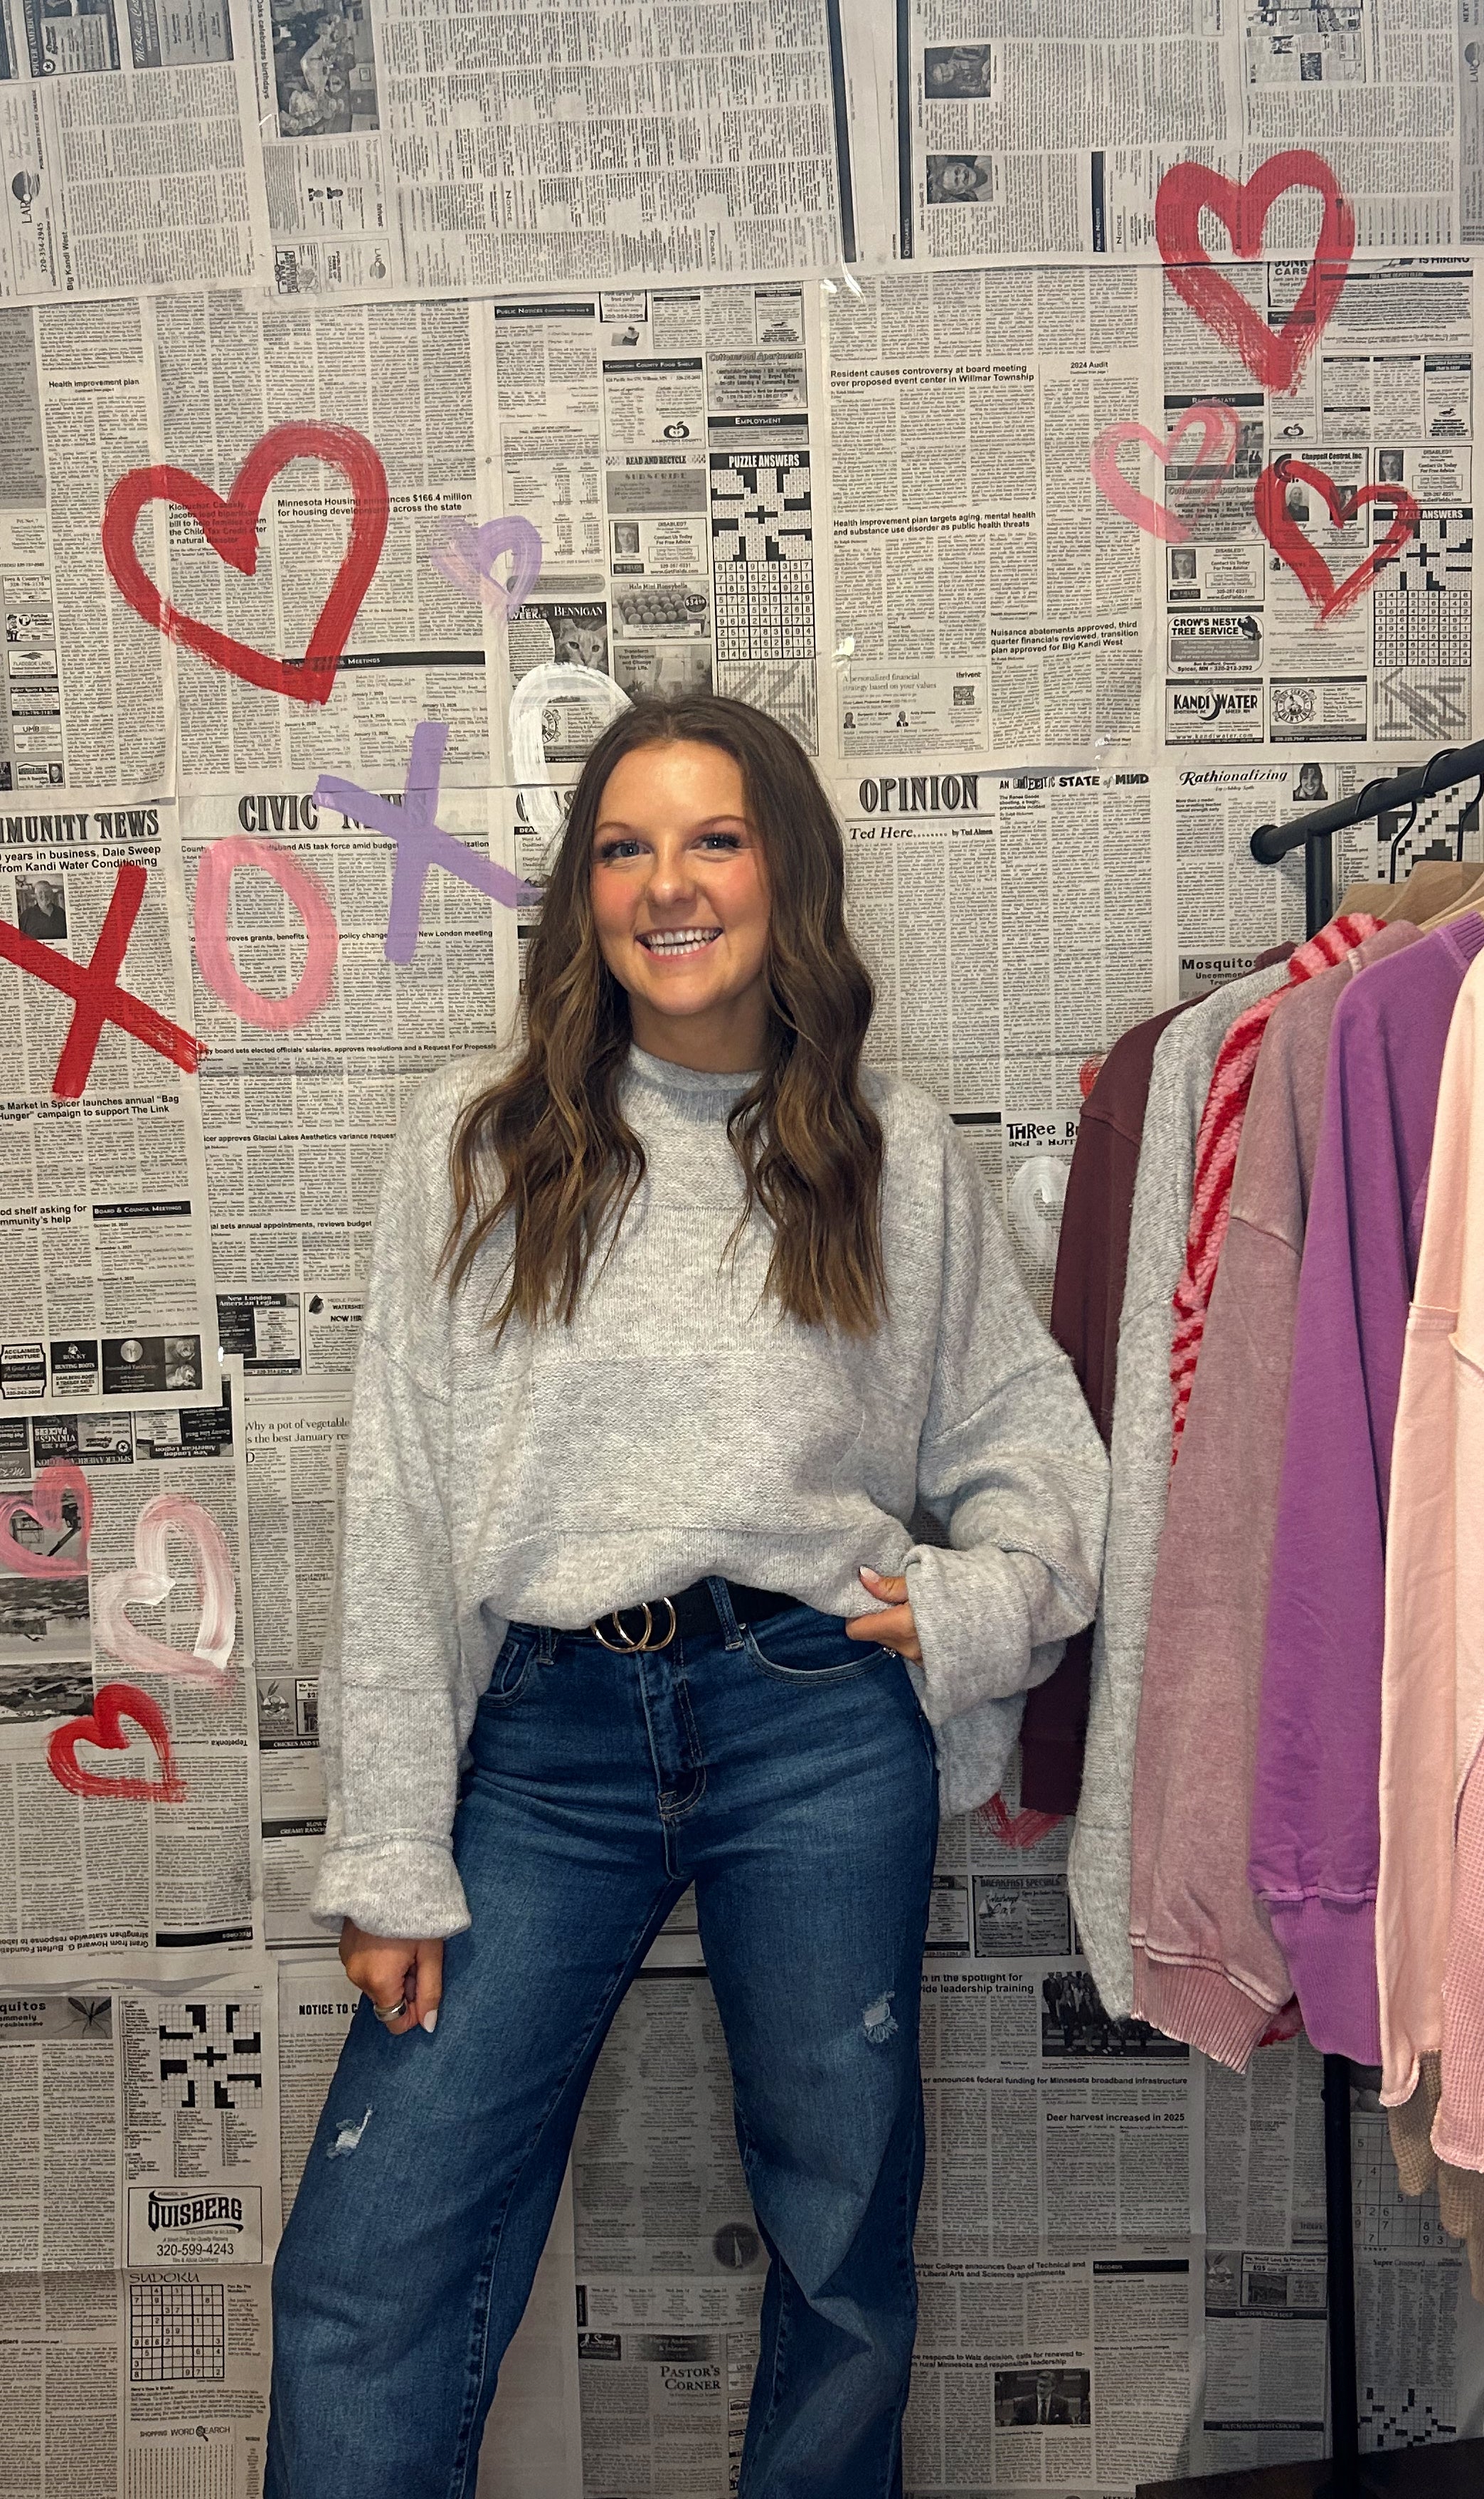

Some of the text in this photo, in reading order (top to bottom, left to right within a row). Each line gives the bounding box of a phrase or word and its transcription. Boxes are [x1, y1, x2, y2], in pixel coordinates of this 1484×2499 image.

[258, 19, 267, 60] celebrates
[260, 63, 270, 100] birthdays
[61, 231, 74, 290] Big Kandi West
[830, 364, 1028, 379] Resident causes controversy at board meeting
[47, 378, 139, 389] Health improvement plan
[852, 378, 892, 389] proposed
[894, 376, 918, 385] event
[958, 374, 992, 383] Willmar
[993, 373, 1034, 382] Township
[729, 455, 800, 467] PUZZLE ANSWERS
[413, 492, 472, 502] $166.4 million
[277, 498, 322, 510] Minnesota
[292, 507, 327, 517] housing
[1422, 509, 1463, 519] ANSWERS
[833, 511, 1036, 529] Health improvement plan targets aging, mental health
[906, 524, 939, 533] disorder
[952, 523, 975, 532] public
[554, 606, 603, 617] BENNIGAN
[1029, 626, 1075, 635] abatements
[1076, 622, 1116, 633] approved,
[1118, 620, 1137, 630] third
[1174, 618, 1238, 627] CROW'S NEST
[1199, 627, 1239, 635] SERVICE
[990, 630, 1138, 648] quarter financials reviewed, transition
[991, 645, 1007, 655] plan
[1009, 644, 1046, 655] approved
[1062, 642, 1076, 650] Big
[1078, 640, 1101, 648] Kandi
[1174, 693, 1258, 709] KANDI WATER
[1000, 780, 1009, 790] AN
[1058, 774, 1101, 788] STATE
[1103, 776, 1113, 787] of
[1115, 773, 1150, 786] MIND
[1179, 768, 1288, 787] Rathionalizing
[859, 775, 979, 813] OPINION
[238, 795, 318, 832] CIVIC
[0, 809, 159, 844] MUNITY NEWS
[849, 828, 876, 840] Ted
[4, 846, 161, 862] years in business, Dale Sweep
[26, 861, 56, 871] Kandi
[58, 860, 88, 870] Water
[91, 857, 157, 869] Conditioning
[417, 927, 434, 937] New
[7, 1101, 38, 1110] Market
[40, 1100, 48, 1109] in
[51, 1099, 80, 1109] Spicer
[83, 1097, 122, 1106] launches
[124, 1095, 154, 1104] annual
[37, 1109, 81, 1119] campaign
[95, 1106, 129, 1117] support
[14, 1206, 38, 1215] shelf
[39, 1205, 70, 1215] asking
[73, 1204, 88, 1212] for
[51, 1215, 71, 1225] help
[277, 1421, 292, 1432] pot
[294, 1418, 304, 1429] of
[254, 1432, 334, 1444] the best January
[1008, 1973, 1023, 1982] for
[940, 1983, 1034, 1993] leadership training
[299, 2003, 349, 2015] NOTICE TO
[1046, 2113, 1184, 2122] Deer harvest increased in 2025
[148, 2197, 243, 2231] QUISBERG
[157, 2244, 235, 2256] 320-599-4243
[129, 2273, 199, 2283] SUDOKU
[660, 2365, 721, 2378] PASTOR'S
[664, 2378, 721, 2391] CORNER
[171, 2425, 230, 2437] WORD SEARCH
